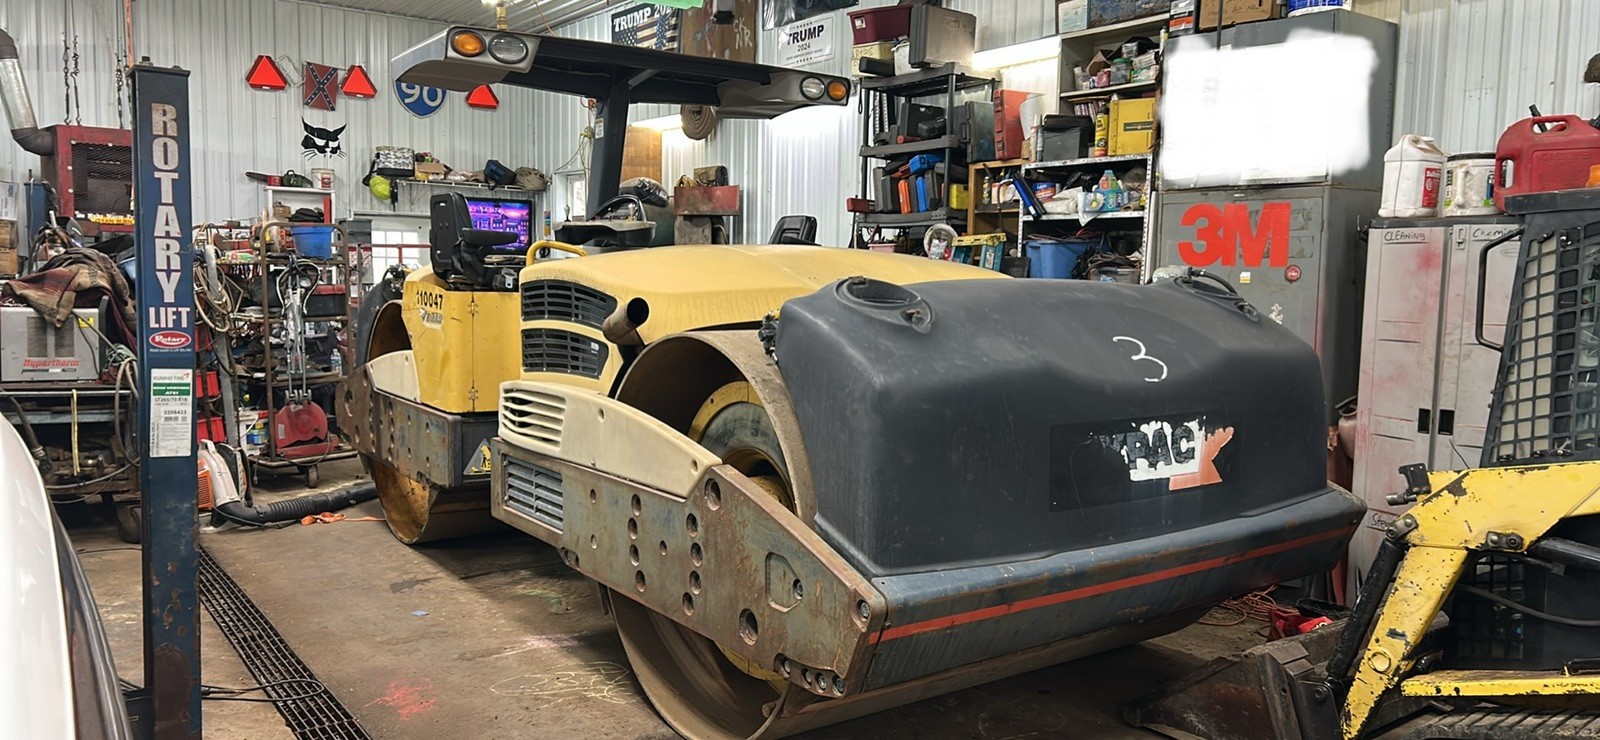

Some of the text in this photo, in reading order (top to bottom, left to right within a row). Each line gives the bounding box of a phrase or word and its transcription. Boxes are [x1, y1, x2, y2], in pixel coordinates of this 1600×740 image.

[613, 7, 652, 32] TRUMP
[787, 24, 824, 45] TRUMP
[797, 42, 811, 52] 2024
[401, 82, 443, 107] 90
[151, 102, 182, 303] ROTARY
[1176, 202, 1292, 268] 3M
[149, 307, 190, 328] LIFT
[23, 358, 79, 367] Hypertherm
[1112, 335, 1168, 382] 3
